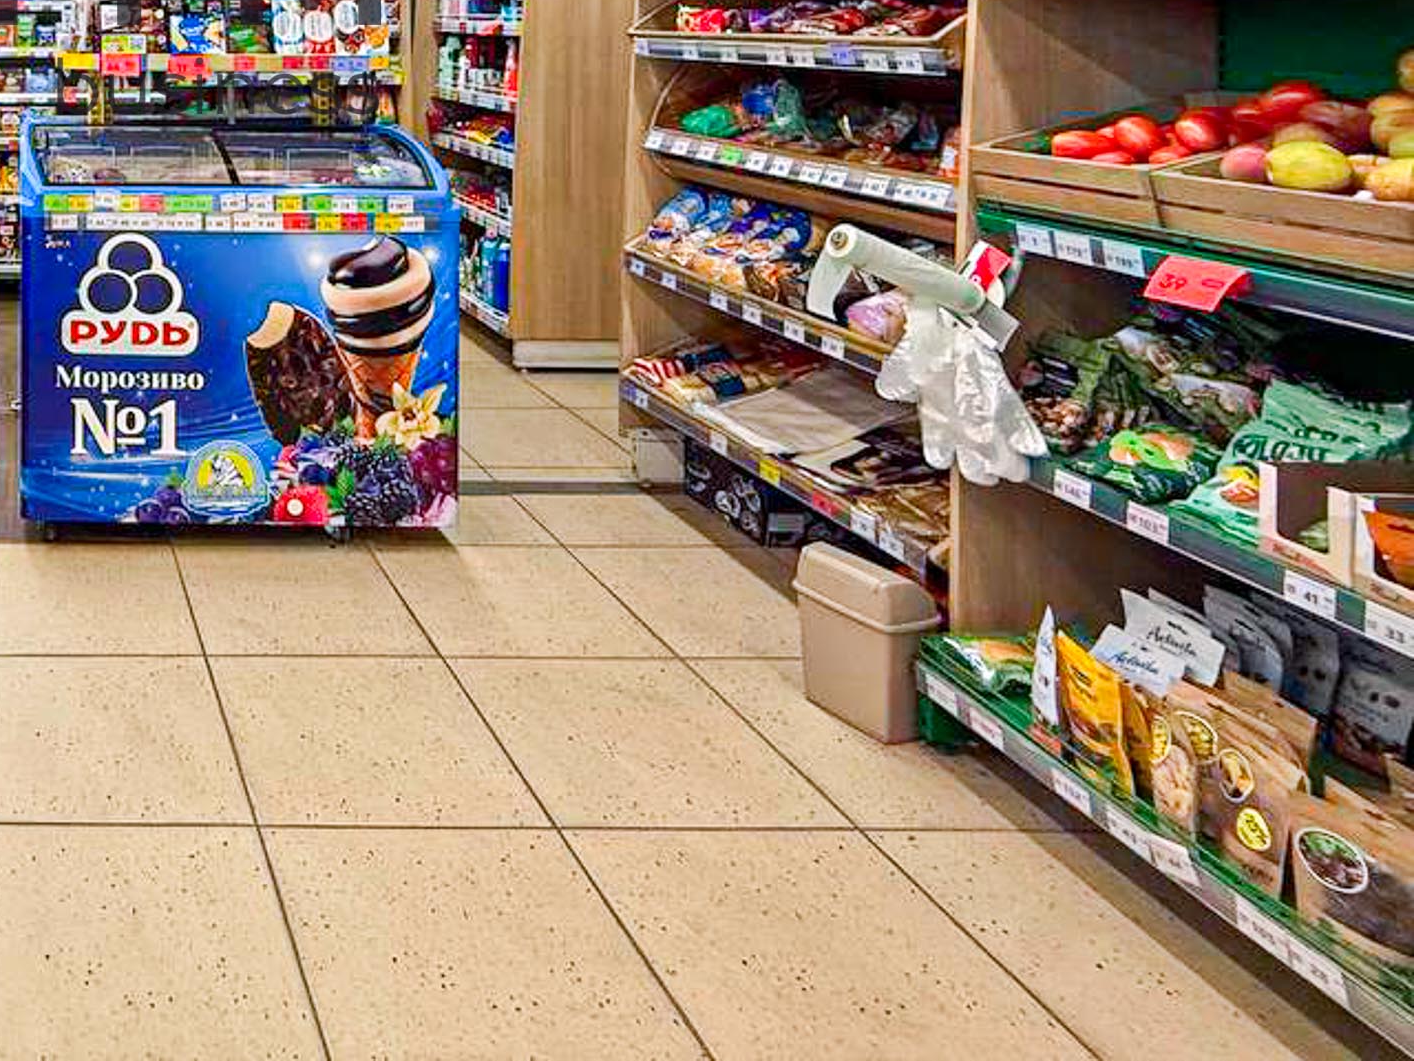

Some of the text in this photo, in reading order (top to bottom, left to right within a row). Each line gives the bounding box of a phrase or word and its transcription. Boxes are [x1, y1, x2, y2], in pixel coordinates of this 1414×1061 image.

[69, 320, 191, 346] РУДЬ
[55, 364, 205, 392] Морозиво
[70, 398, 188, 458] №1
